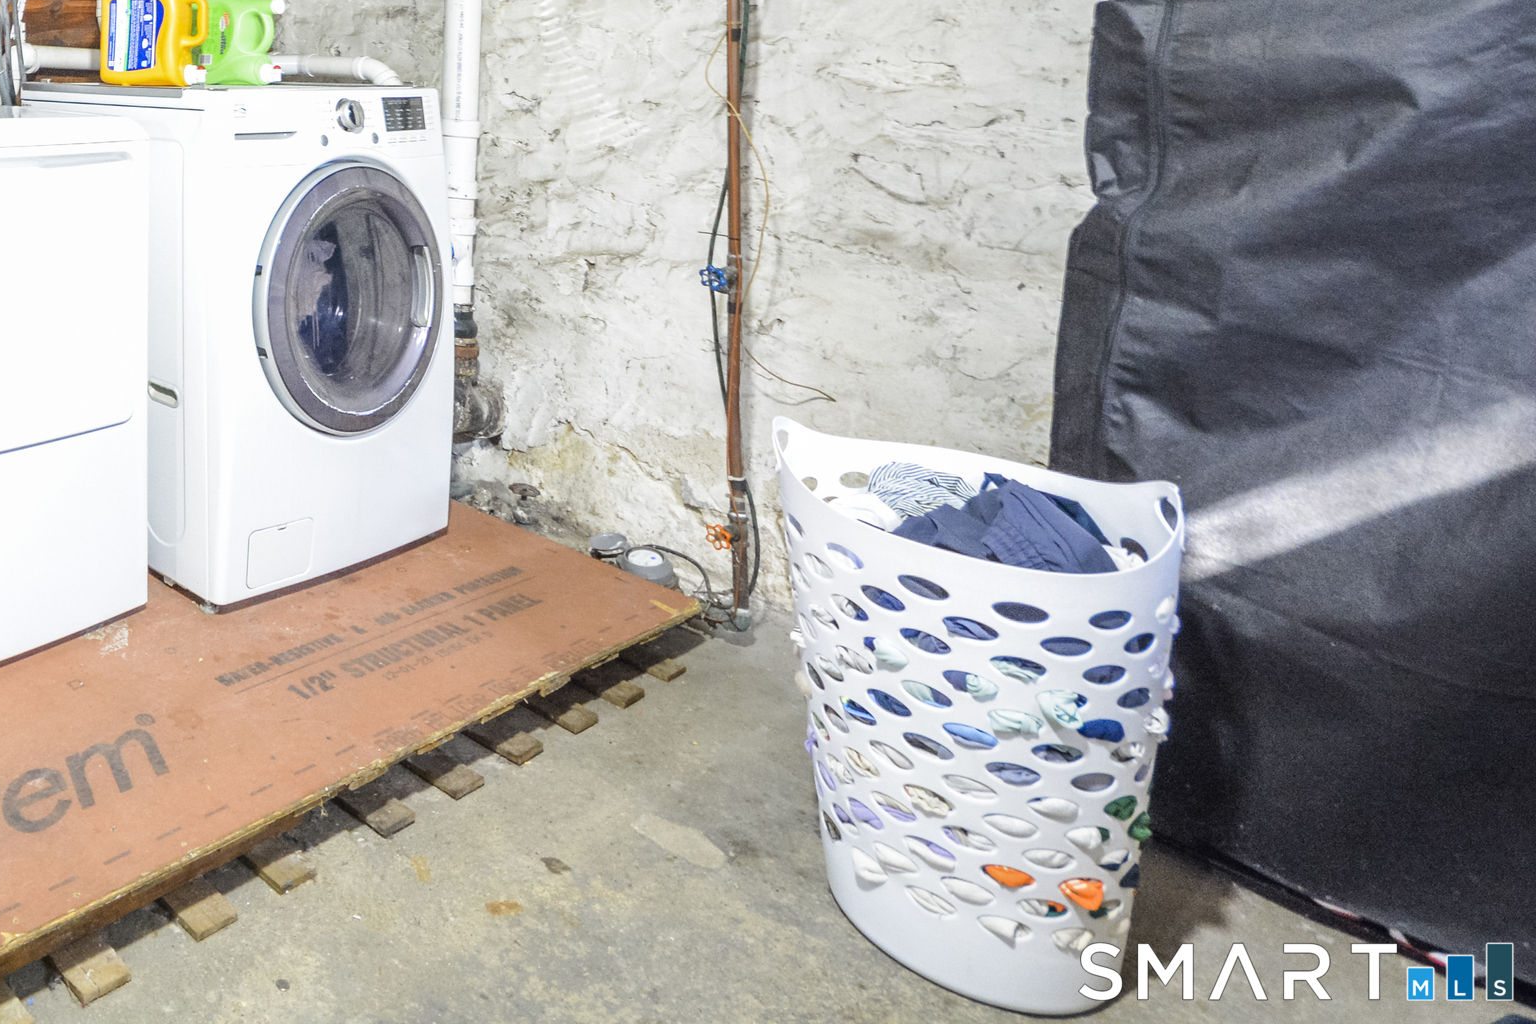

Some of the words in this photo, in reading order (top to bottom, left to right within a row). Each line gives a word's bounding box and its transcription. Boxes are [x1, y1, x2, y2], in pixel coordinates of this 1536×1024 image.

[215, 633, 344, 687] WATER-RESISTIVE
[399, 591, 457, 616] BARRIER
[452, 566, 524, 595] PROTECTION
[287, 669, 337, 700] 1/2"
[338, 621, 472, 679] STRUCTURAL
[476, 592, 544, 622] PANEL
